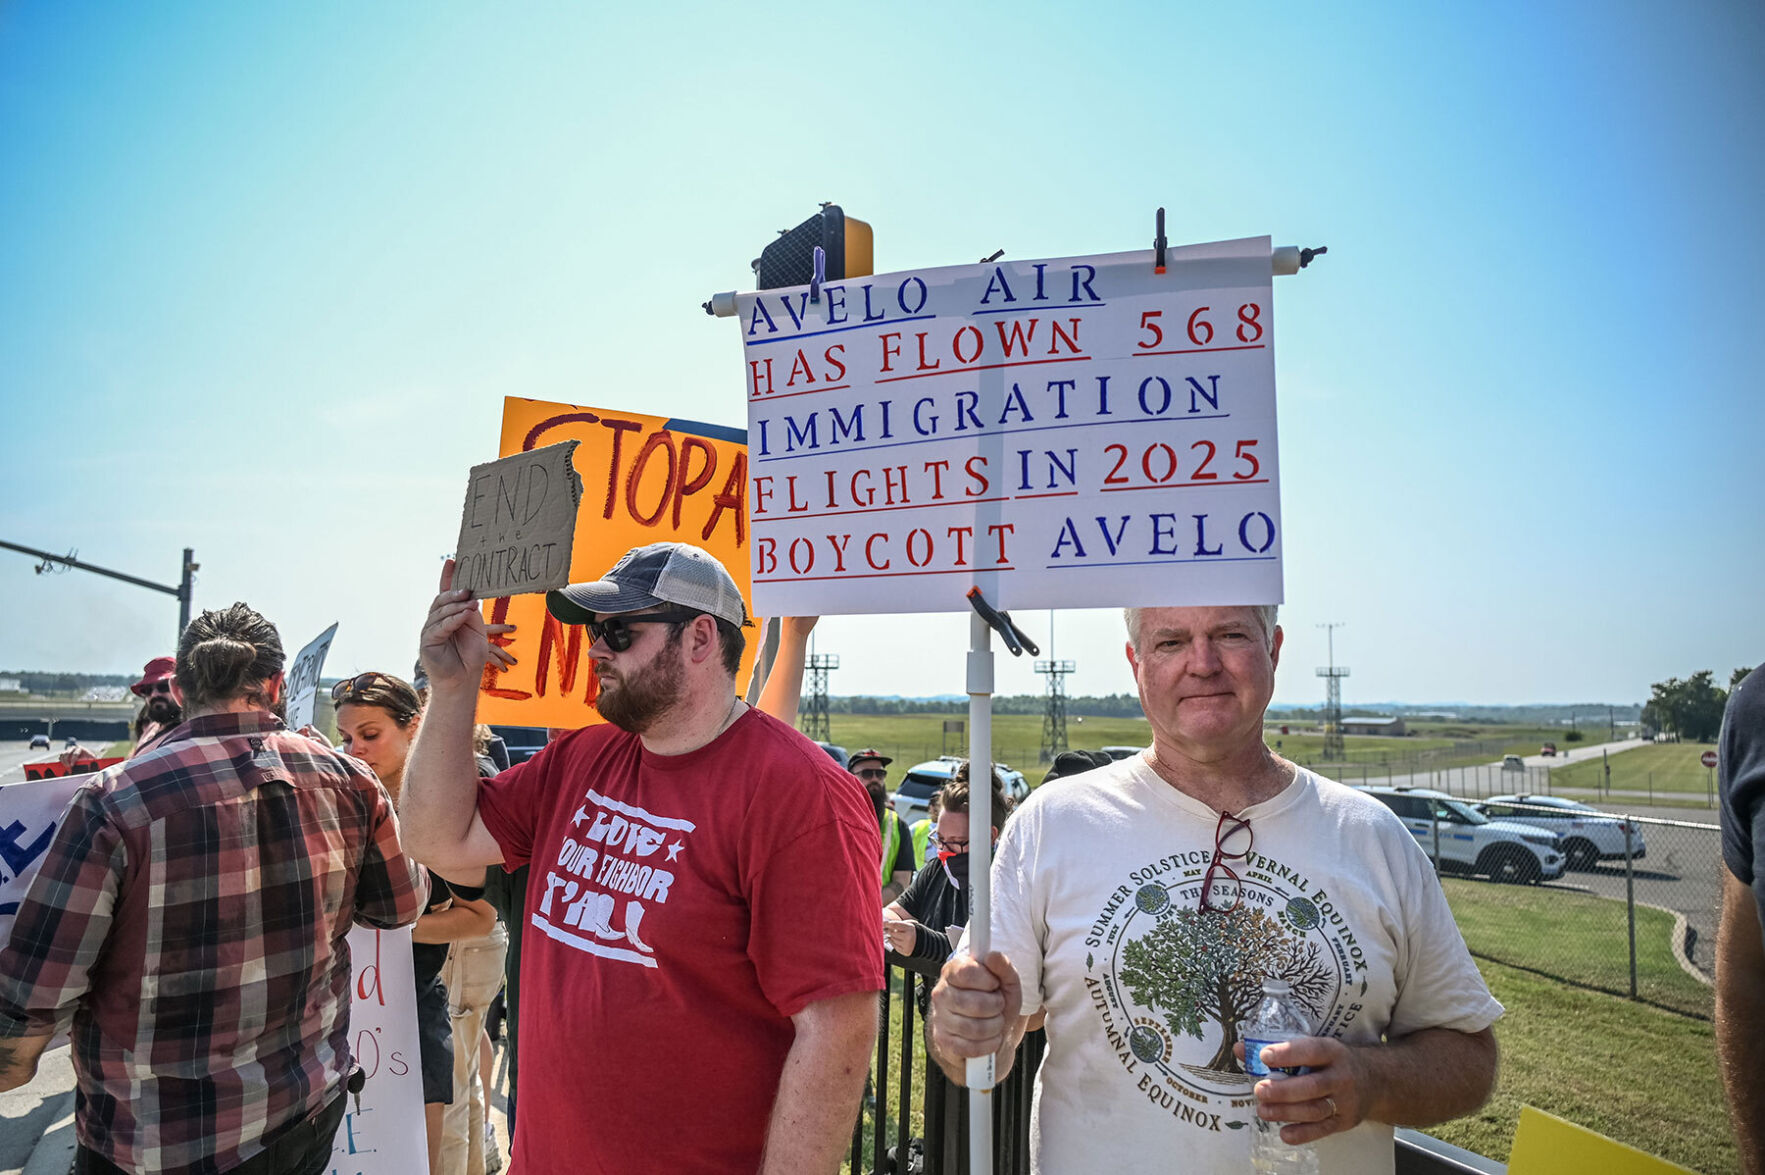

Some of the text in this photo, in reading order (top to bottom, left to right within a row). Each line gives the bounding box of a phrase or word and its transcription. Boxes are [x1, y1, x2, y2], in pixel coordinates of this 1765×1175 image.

[747, 264, 1102, 336] AVELO AIR
[750, 302, 1265, 397] HAS FLOWN 568
[756, 374, 1223, 456] IMMIGRATION
[471, 463, 549, 529] END
[752, 439, 1261, 514] FLIGHTS IN 2025
[456, 542, 557, 593] CONTRACT
[757, 511, 1277, 575] BOYCOTT AVELO
[557, 836, 599, 880] OUR
[585, 811, 667, 857] LOVE
[1180, 884, 1275, 908] TH SEASONS
[1183, 868, 1202, 878] MAY
[1245, 870, 1273, 885] APRIL
[1084, 850, 1211, 949] SUMMER SOLSTICE
[1245, 851, 1368, 973] VERNAL EQUINOX
[1276, 910, 1308, 939] MARCH
[1106, 923, 1120, 946] JULY
[1084, 976, 1222, 1133] AUTUMNAL EQUINOX
[1133, 1016, 1173, 1064] SEPTEMBER
[1166, 1076, 1209, 1104] OCTOBER
